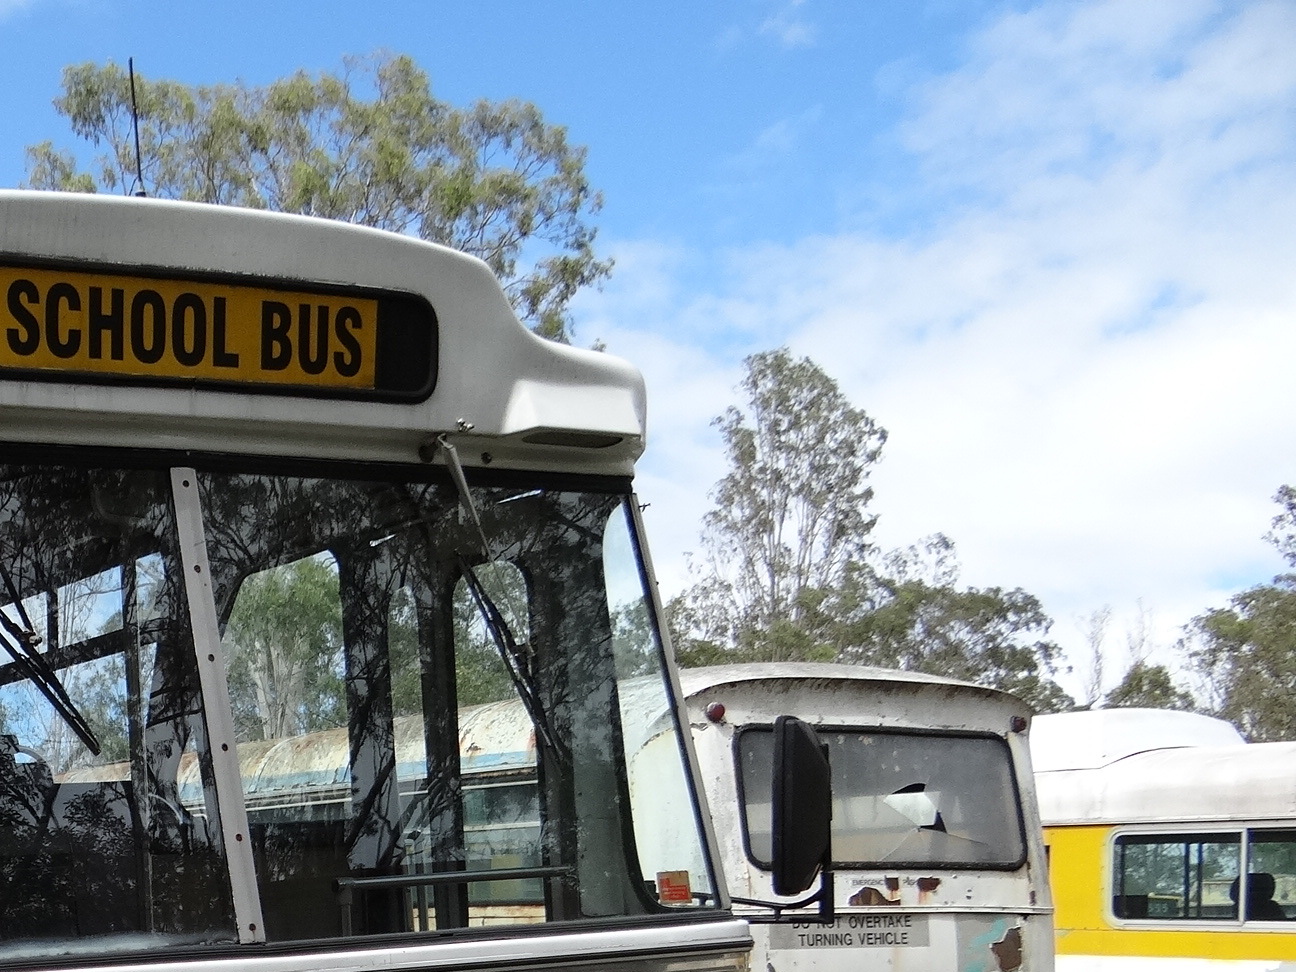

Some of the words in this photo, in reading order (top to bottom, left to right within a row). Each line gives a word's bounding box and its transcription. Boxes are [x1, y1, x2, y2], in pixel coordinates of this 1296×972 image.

[6, 279, 240, 368] SCHOOL
[260, 300, 364, 377] BUS
[848, 915, 912, 929] OVERTAKE
[798, 933, 853, 947] TURNING
[858, 932, 908, 945] VEHICLE
